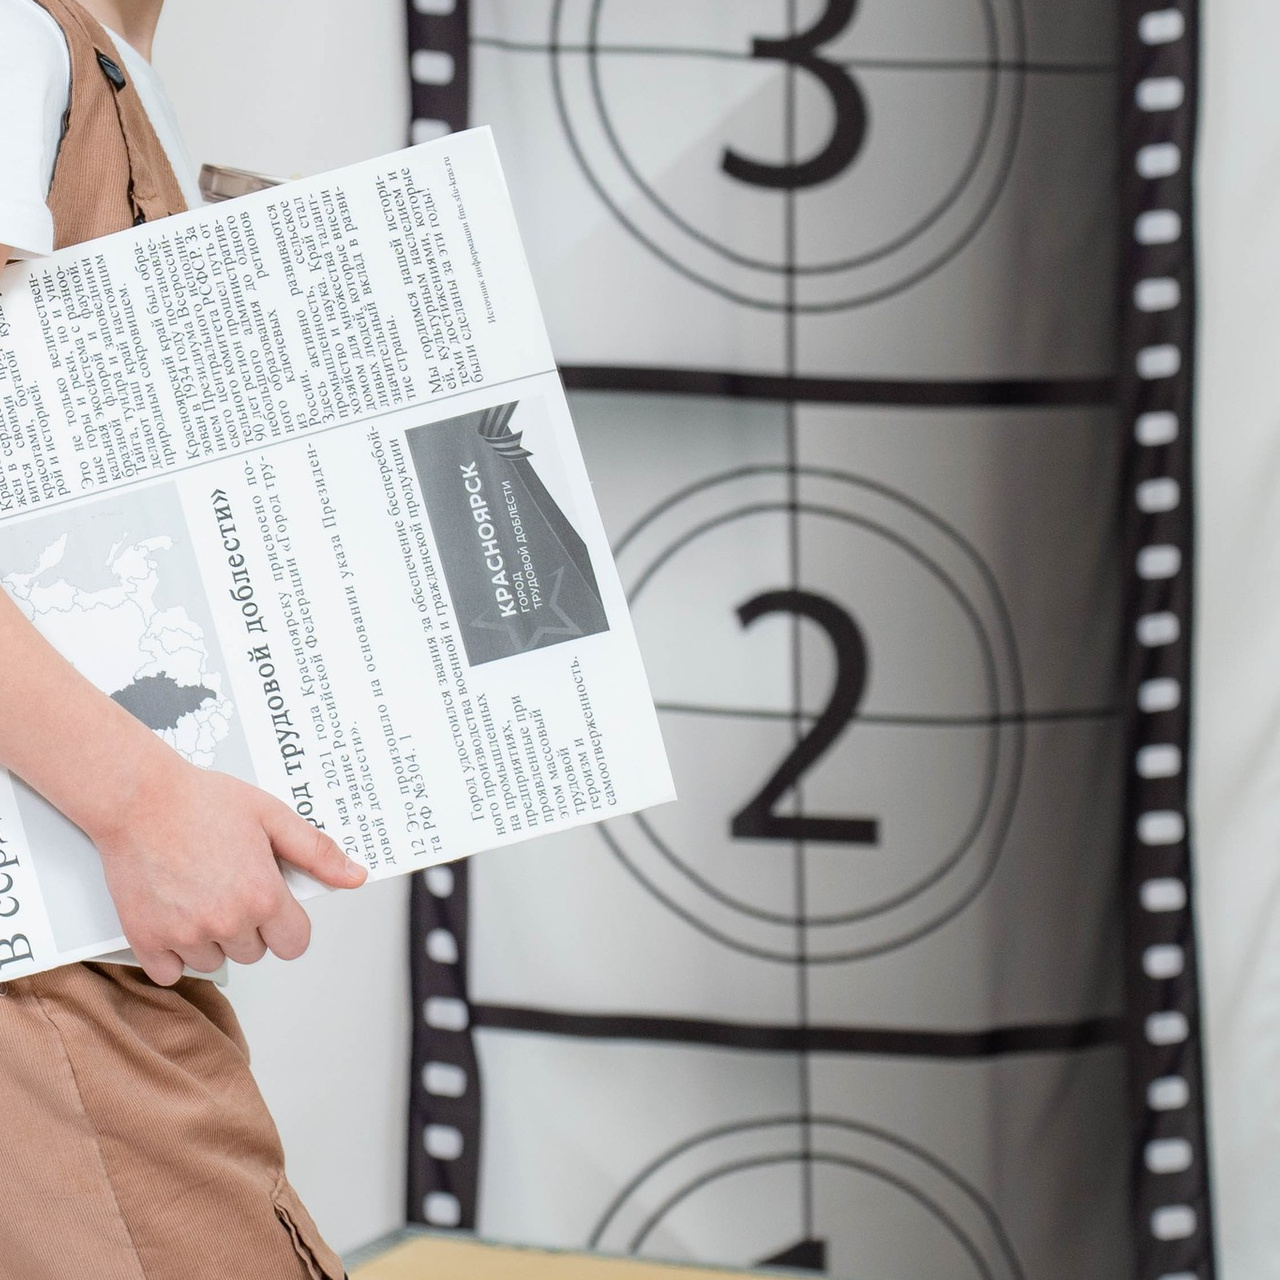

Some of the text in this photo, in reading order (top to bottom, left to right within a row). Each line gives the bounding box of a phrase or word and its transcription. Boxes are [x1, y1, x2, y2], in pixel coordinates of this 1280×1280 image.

[134, 242, 201, 460] Красноярский край был обра-
[157, 234, 227, 452] нием Президиума Всероссий-
[174, 230, 241, 448] ского центрального исполни-
[214, 219, 281, 437] небольшого административ-
[226, 215, 295, 433] ного образования до одного
[240, 211, 309, 430] из ключевых регионов
[266, 204, 335, 424] Здесь активно развиваются
[280, 200, 350, 419] промышленность, сельское
[308, 193, 378, 411] домом для множества талант-
[375, 175, 444, 394] Мы гордимся нашей истори-
[400, 167, 470, 387] теми достижениями, которые
[462, 221, 483, 278] информации
[478, 279, 496, 324] Источник
[28, 273, 94, 490] Это не только величествен-
[65, 261, 139, 478] бразной флорой и фауной.
[81, 257, 148, 473] Тайга, тундра и заповедники
[94, 254, 164, 469] делают наш край настоящим
[118, 283, 177, 466] природным сокровищем.
[300, 369, 322, 427] России.
[210, 488, 305, 776] трудовой доблести»
[366, 425, 485, 822] Город удостоился звания за обеспечение бесперебой-
[389, 438, 506, 836] ного производства военной и гражданской продукции
[459, 461, 512, 618] КРАСНОЯРСК
[501, 480, 541, 610] ТРУДОВОЙ ДОБЛЕСТИ
[512, 571, 532, 613] ГОРОД
[244, 460, 359, 857] 20 мая 2021 года Красноярску присвоено по-
[259, 455, 379, 872] чётное звание Российской Федерации «Город тру-
[307, 443, 427, 856] 12 Это произошло на основании указа Президен-
[570, 656, 617, 806] самоотверженность.
[729, 587, 880, 845] 2
[350, 721, 397, 865] довой доблести».
[404, 748, 429, 800] №304.
[419, 805, 437, 830] РФ
[430, 835, 442, 854] та
[476, 693, 522, 832] на промышленных
[502, 719, 539, 828] предприятиях,
[511, 695, 555, 823] проявленные при
[528, 708, 570, 819] этом массовый
[556, 747, 587, 815] трудовой
[573, 737, 602, 810] героизм и
